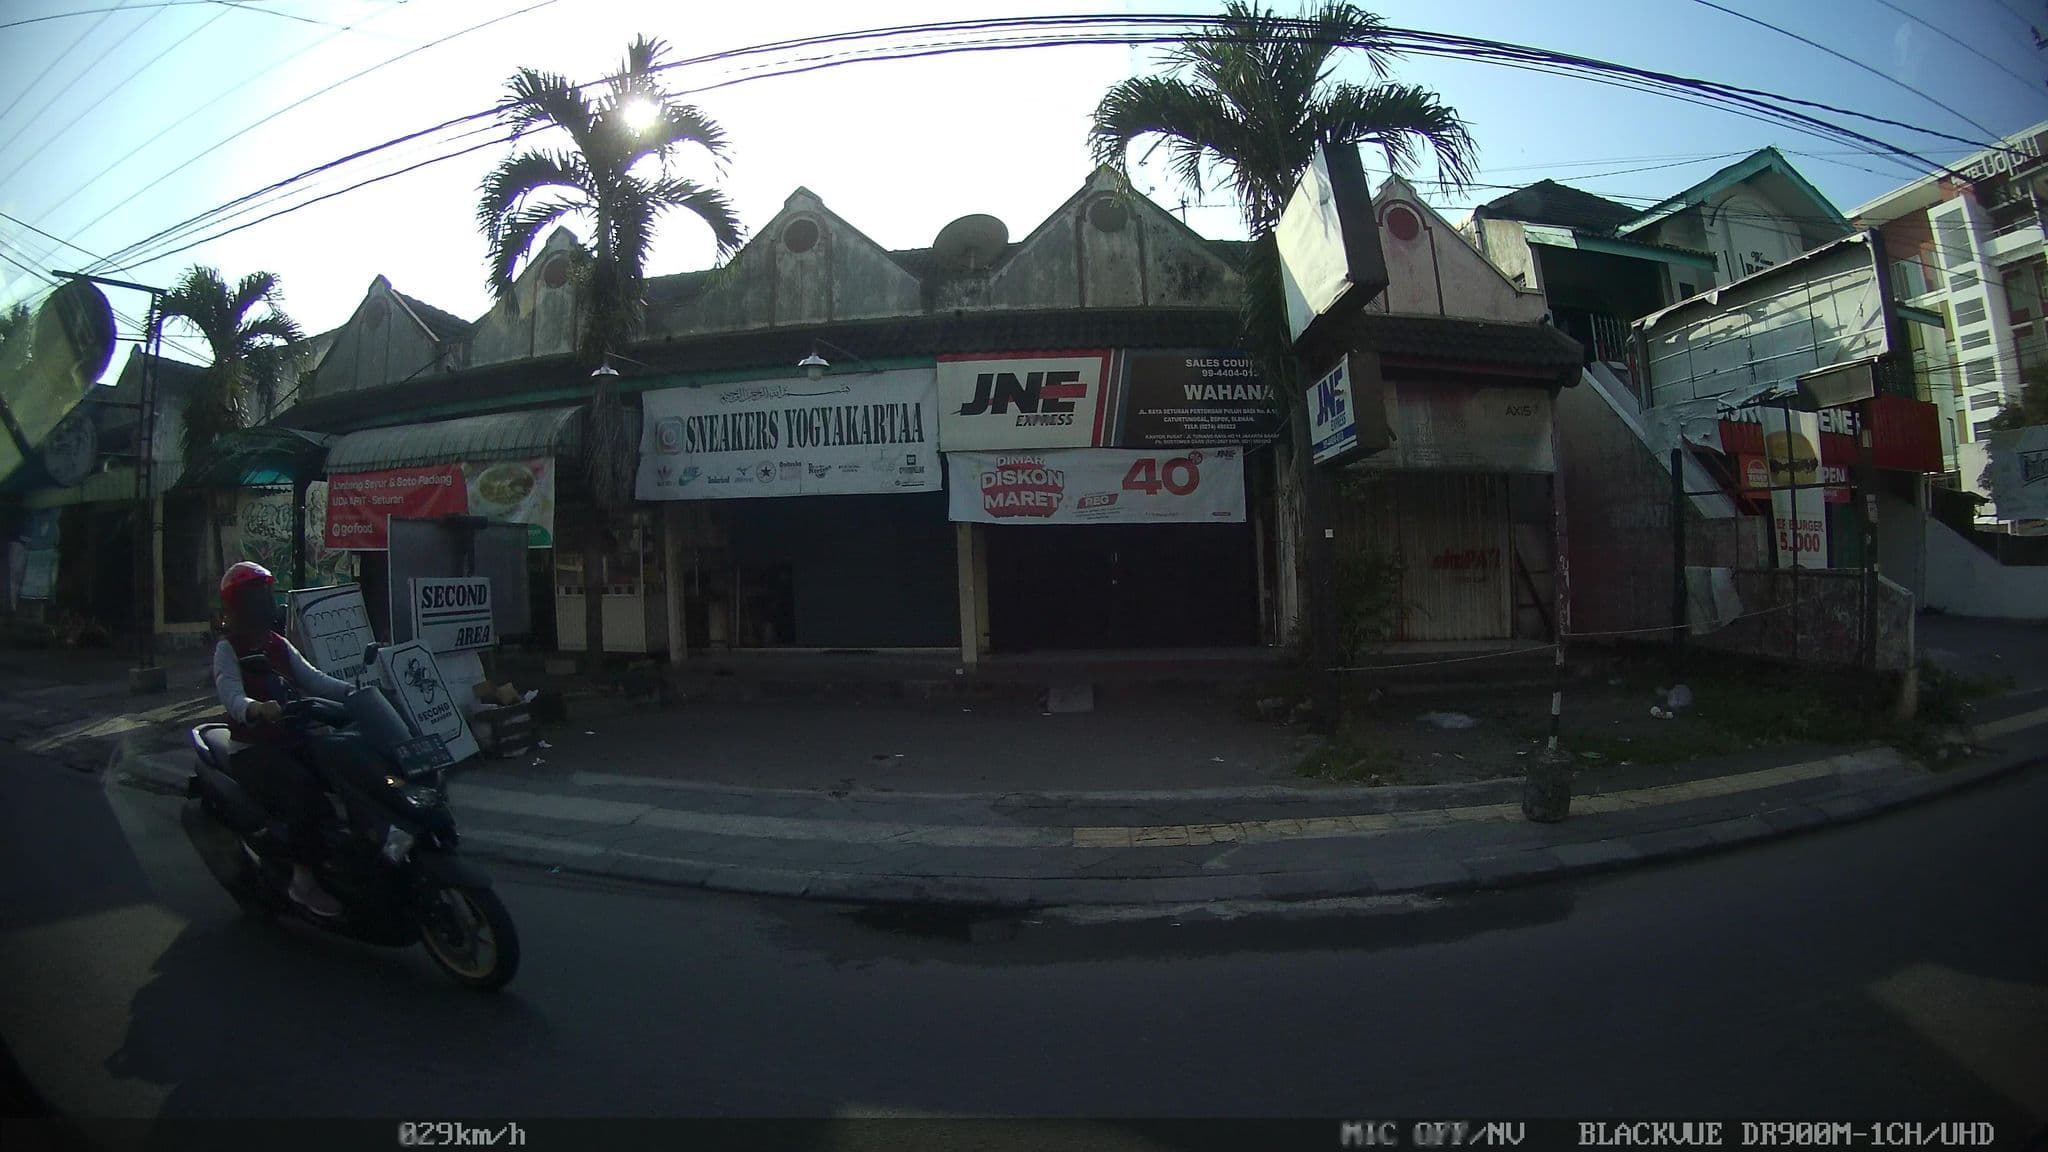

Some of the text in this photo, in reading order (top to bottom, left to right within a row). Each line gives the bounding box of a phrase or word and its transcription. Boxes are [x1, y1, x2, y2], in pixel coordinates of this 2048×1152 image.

[1185, 359, 1220, 367] SALES
[960, 371, 1088, 416] JNE
[1316, 367, 1345, 427] JNE
[1015, 414, 1074, 427] EXPRESS
[1505, 405, 1532, 417] AXIS
[685, 402, 925, 454] SNEAKERS YOGYAKARTAA
[389, 479, 396, 487] &
[418, 474, 452, 487] Padang
[981, 469, 1064, 489] DISKON
[984, 490, 1063, 510] MARET
[421, 584, 488, 609] SECOND
[454, 625, 490, 647] AREA
[417, 702, 451, 722] SECOND
